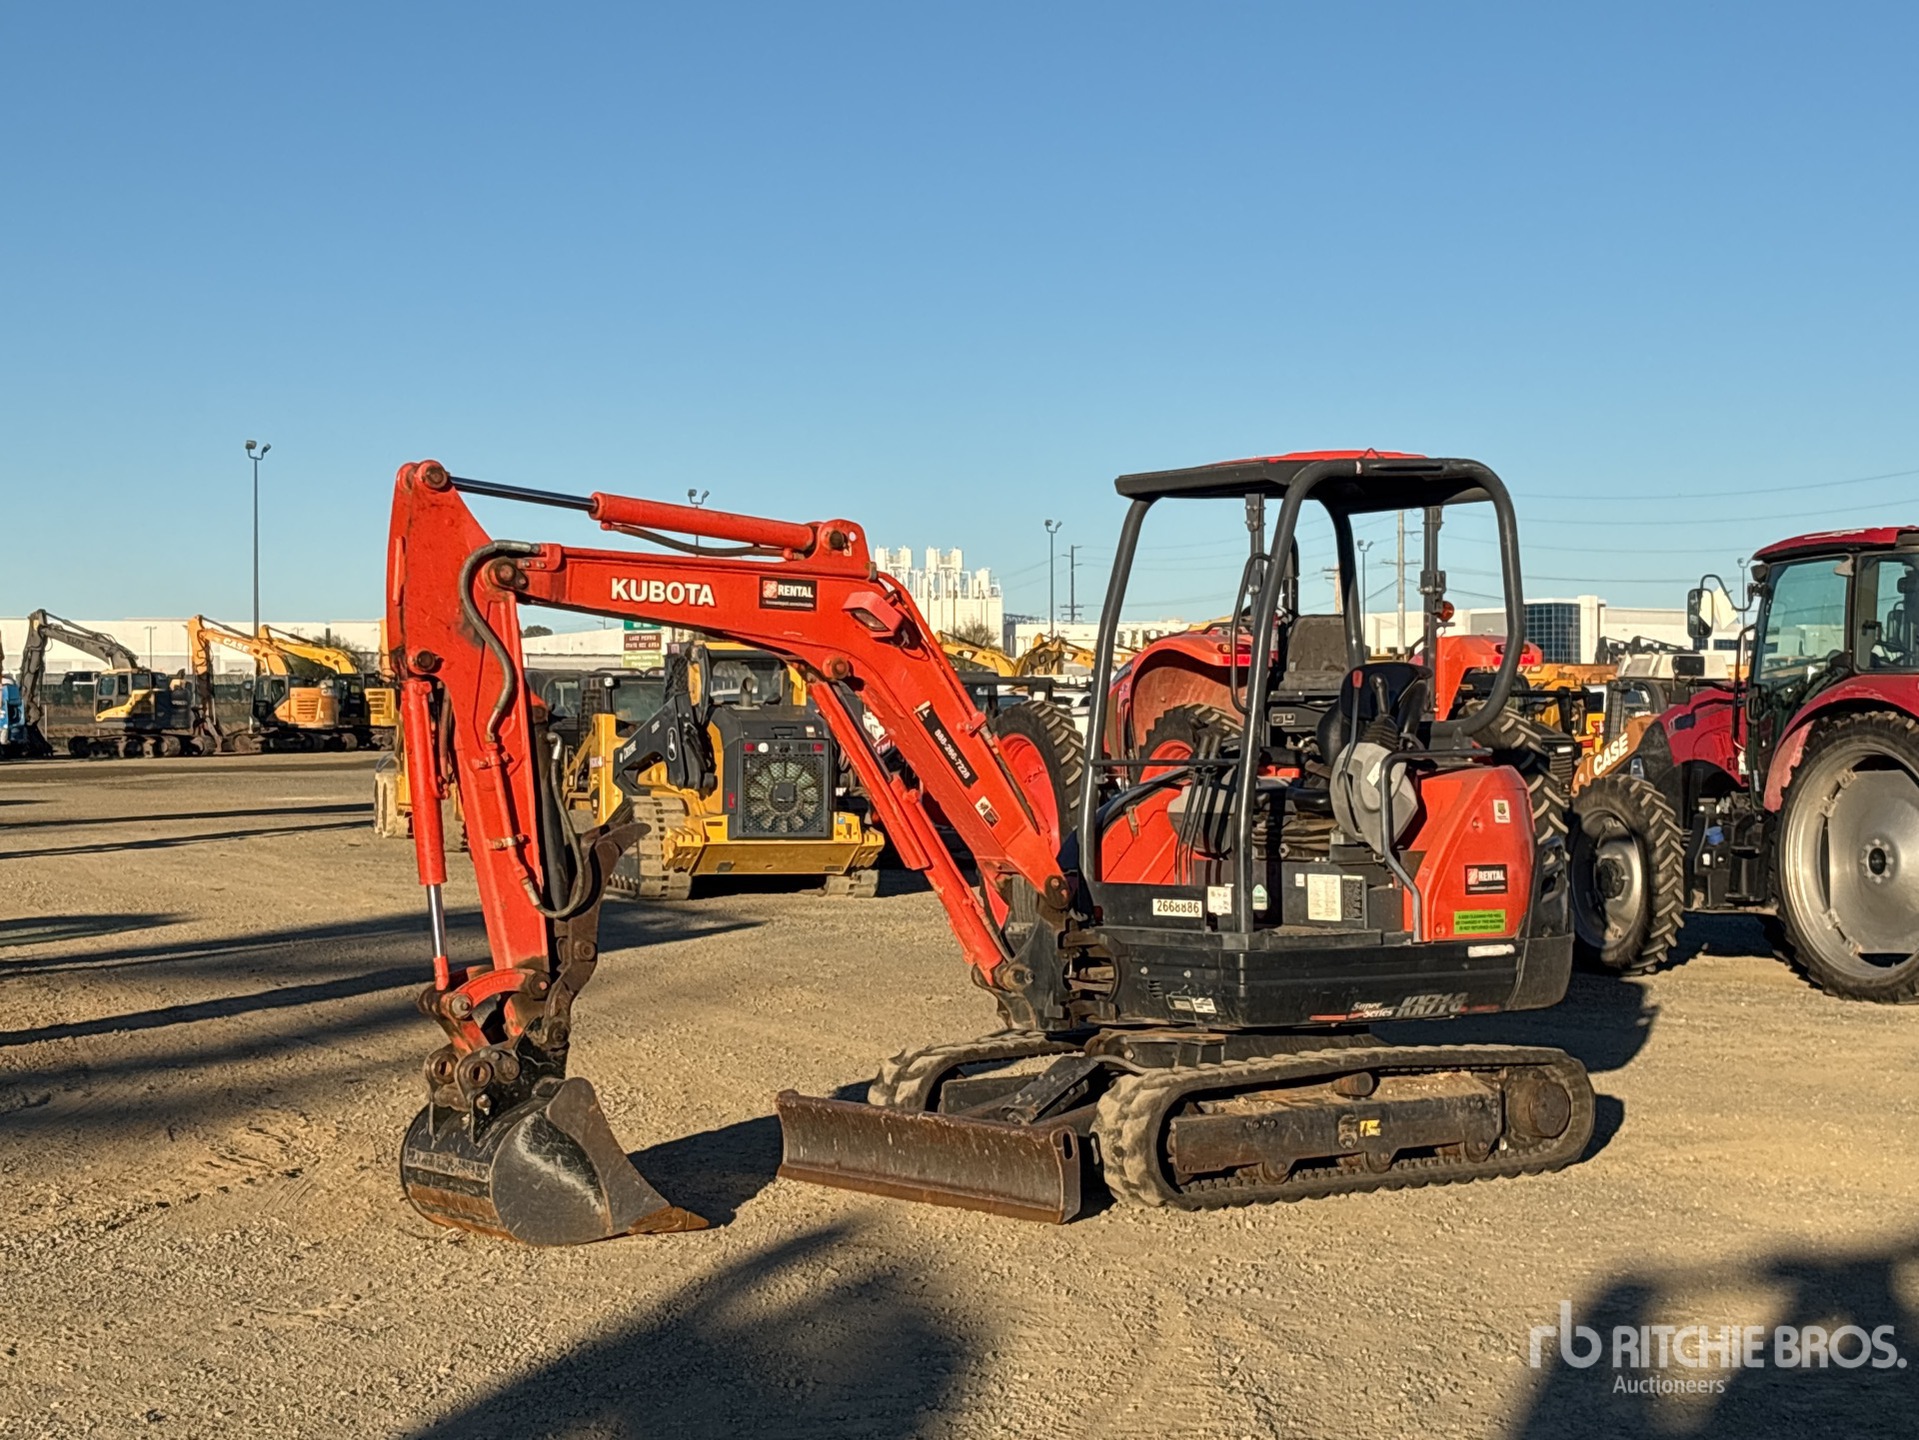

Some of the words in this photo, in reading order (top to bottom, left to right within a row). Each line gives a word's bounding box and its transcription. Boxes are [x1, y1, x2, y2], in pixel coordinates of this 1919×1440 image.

[611, 577, 716, 607] KUBOTA
[777, 584, 814, 599] RENTAL
[1593, 732, 1629, 776] CASE
[1478, 869, 1506, 882] RENTAL
[1351, 1001, 1383, 1012] Super
[1362, 1007, 1394, 1019] Series
